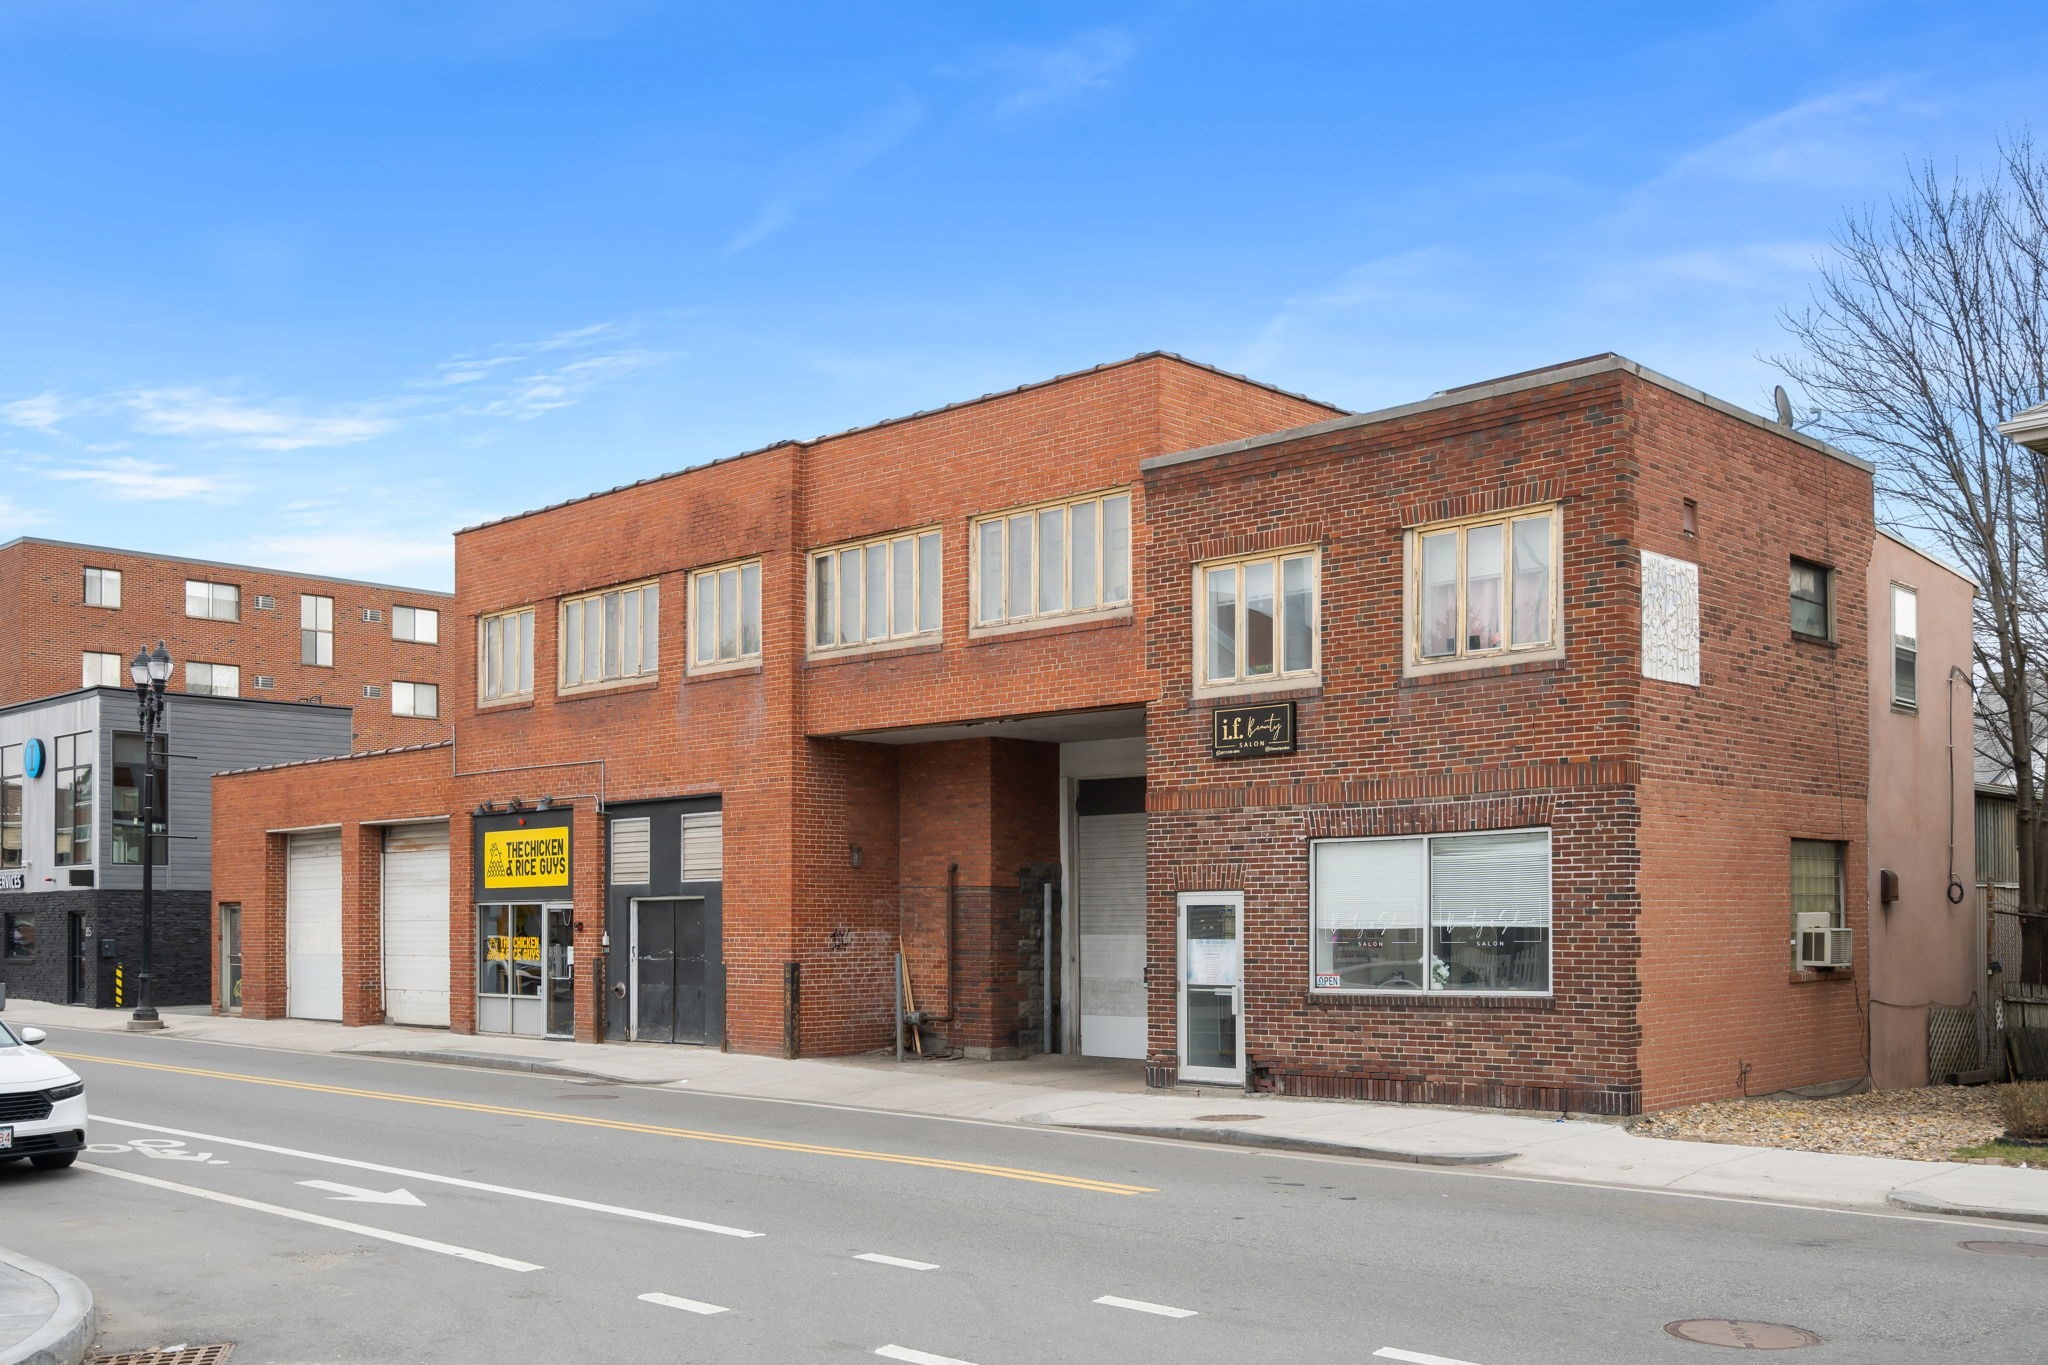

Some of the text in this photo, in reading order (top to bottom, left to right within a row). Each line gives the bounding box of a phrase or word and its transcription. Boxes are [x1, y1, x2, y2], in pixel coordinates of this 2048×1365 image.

[1222, 713, 1282, 740] i.f. Beauty
[1239, 740, 1265, 749] SALON
[506, 838, 564, 858] THE CHICKEN
[506, 856, 566, 877] & RICE GUYS
[500, 936, 539, 949] TH CHICKEN
[522, 948, 540, 960] GUYS
[1318, 976, 1338, 986] OPEN
